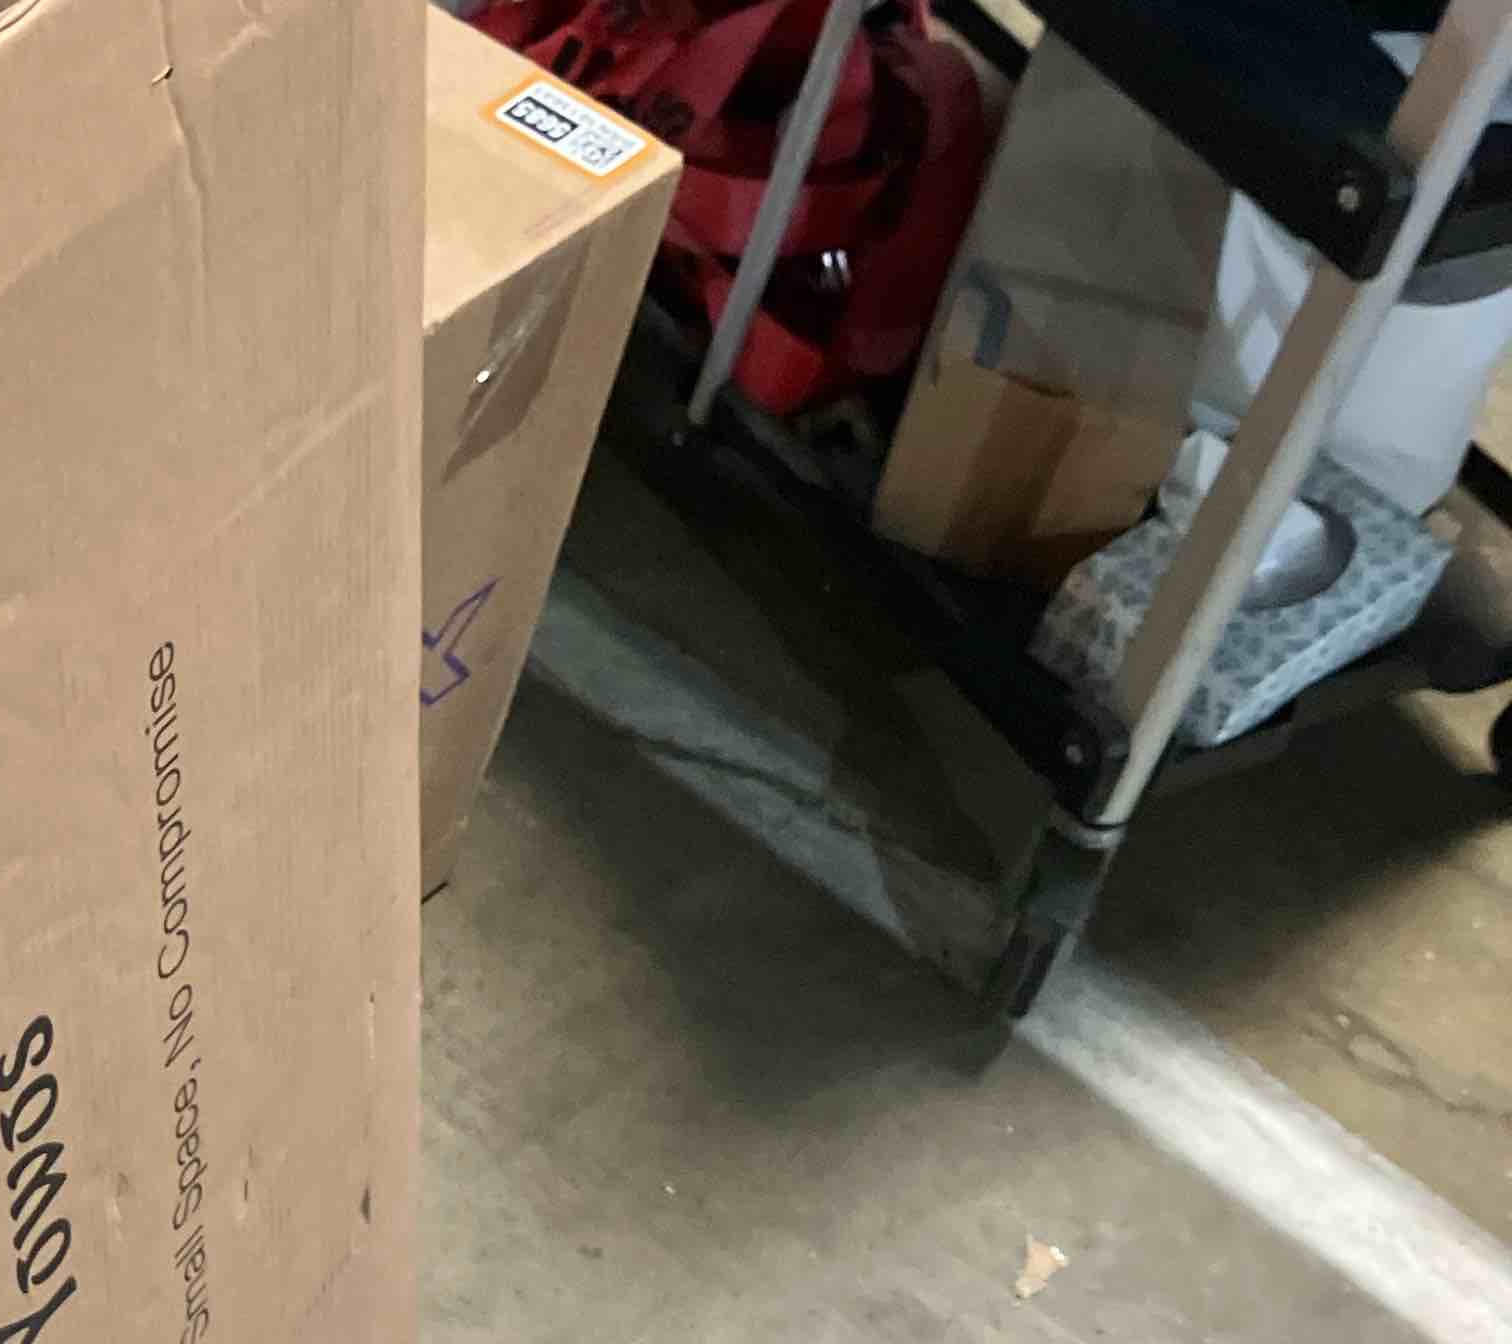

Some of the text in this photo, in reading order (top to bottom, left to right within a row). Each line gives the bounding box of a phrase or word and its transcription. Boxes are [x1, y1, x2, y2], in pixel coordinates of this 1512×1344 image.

[143, 641, 192, 980] Compromise
[162, 984, 194, 1068] No
[172, 1056, 208, 1230] Space,
